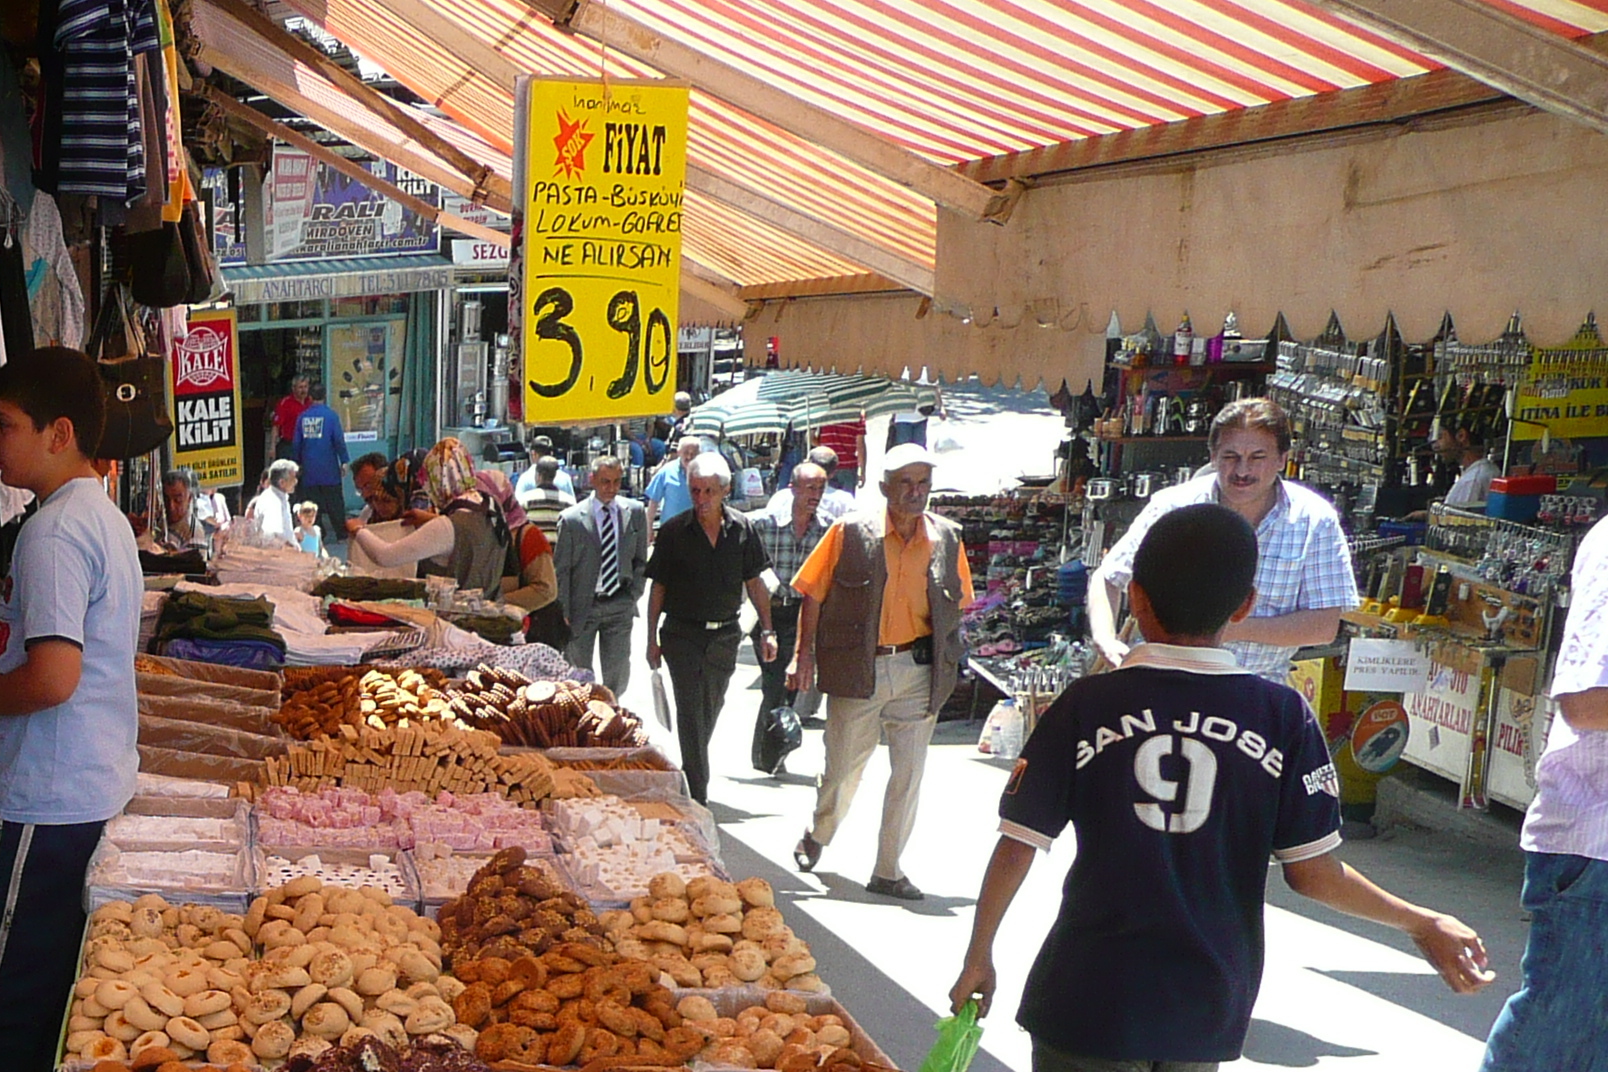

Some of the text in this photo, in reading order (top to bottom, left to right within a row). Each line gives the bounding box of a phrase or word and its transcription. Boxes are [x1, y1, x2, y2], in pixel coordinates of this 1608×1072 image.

[603, 123, 665, 175] FİYAT
[543, 242, 671, 269] NE ALIRSAN
[181, 346, 223, 377] KALE
[178, 396, 231, 423] KALE
[179, 419, 232, 446] KİLİT
[1076, 708, 1283, 778] SAN JOSE
[1133, 734, 1218, 834] 9
